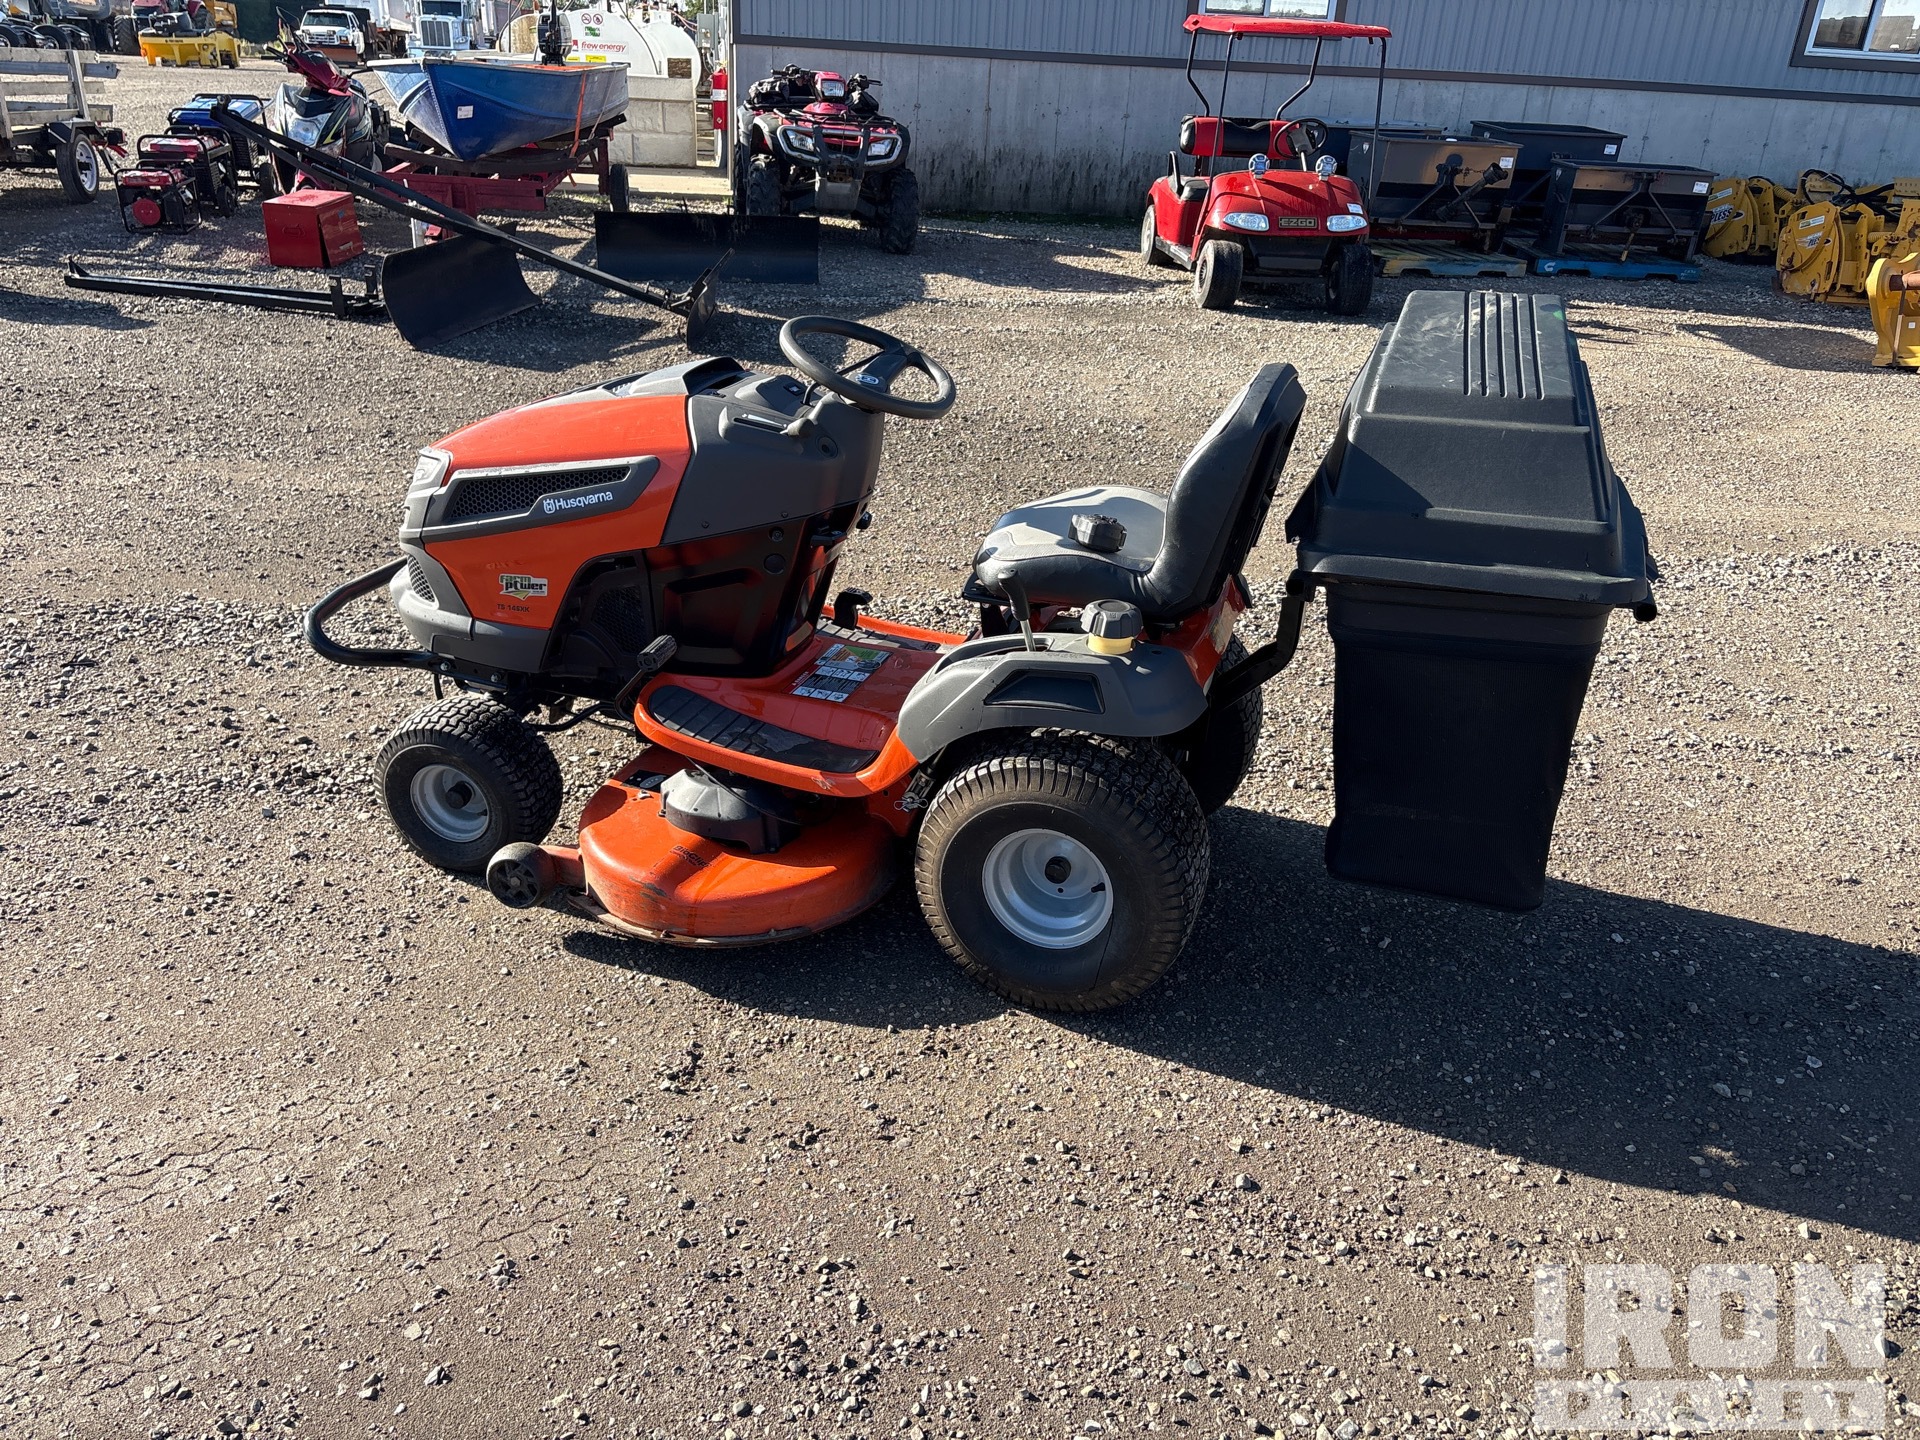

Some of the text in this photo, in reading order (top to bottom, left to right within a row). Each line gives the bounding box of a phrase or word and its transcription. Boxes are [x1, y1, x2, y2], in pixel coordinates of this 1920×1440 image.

[581, 41, 627, 52] frew energy
[555, 491, 613, 510] Husqvarna
